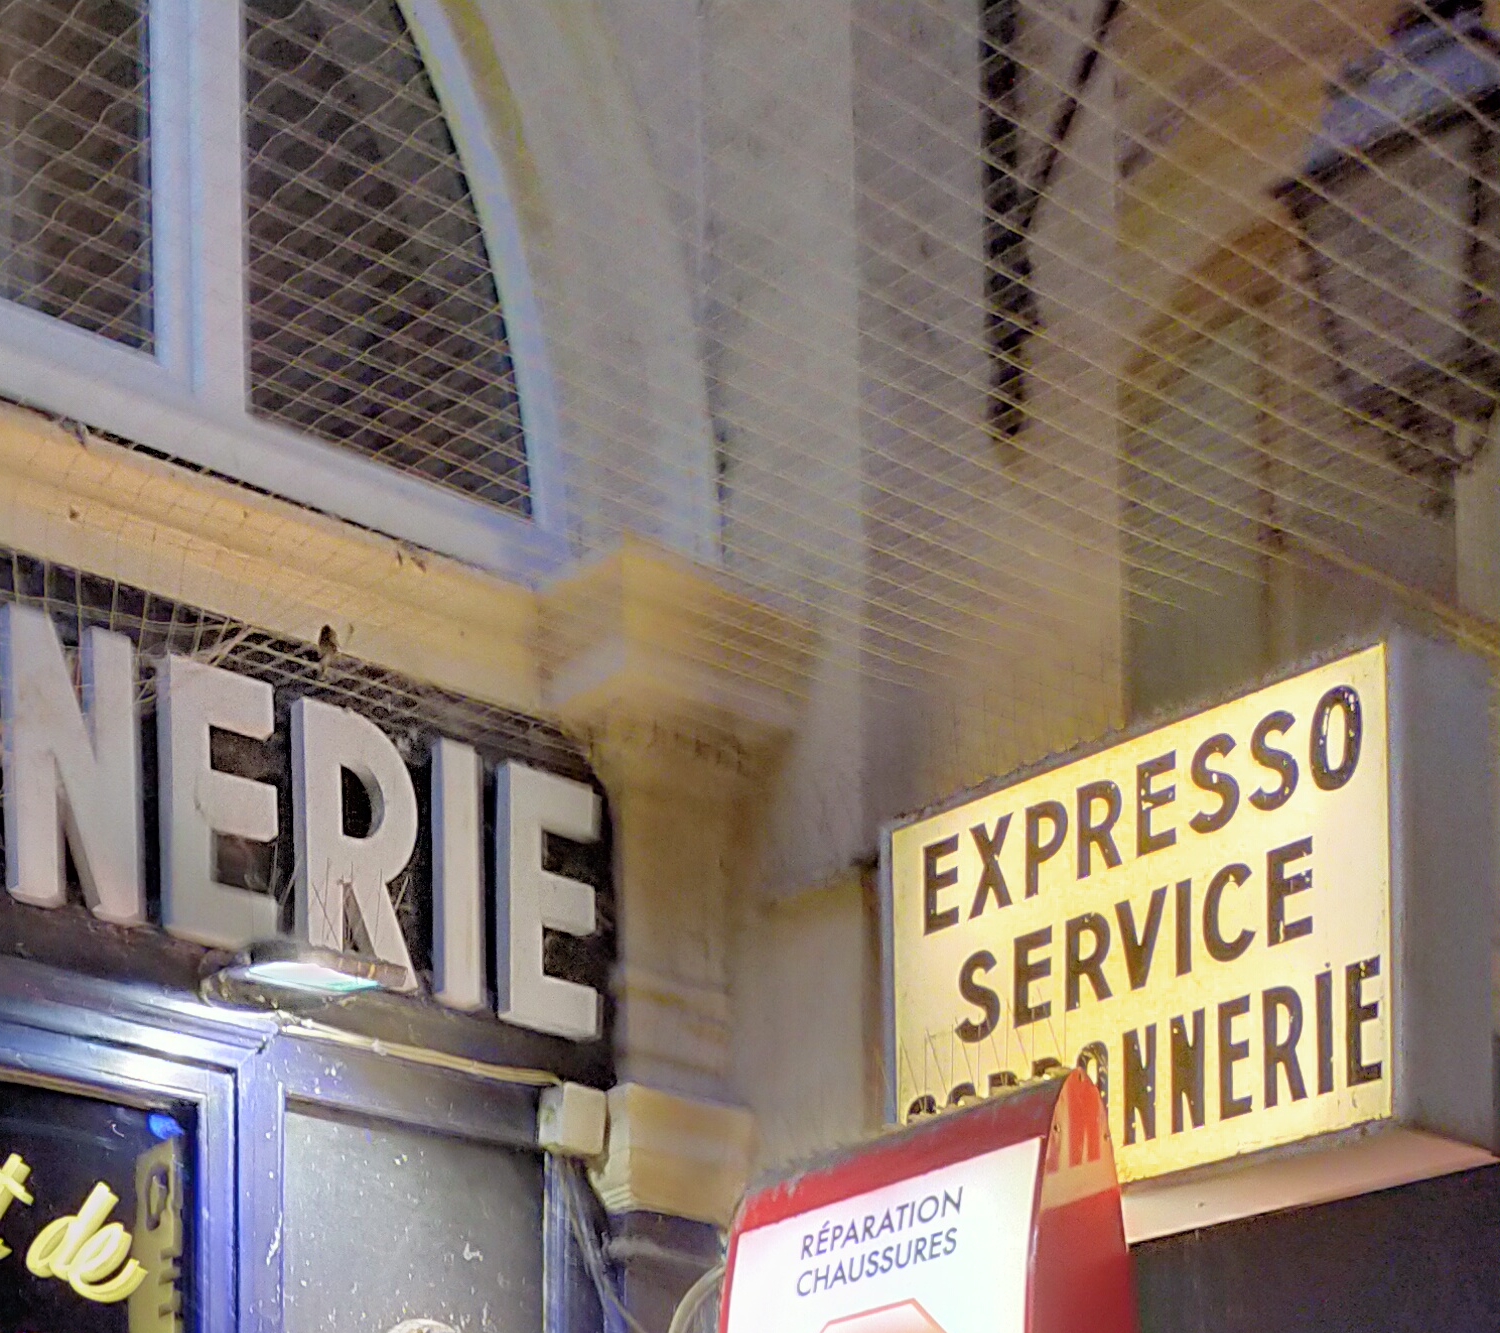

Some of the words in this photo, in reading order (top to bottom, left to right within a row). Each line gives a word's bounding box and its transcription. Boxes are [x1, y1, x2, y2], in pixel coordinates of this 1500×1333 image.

[923, 684, 1362, 936] EXPRESSO
[955, 836, 1314, 1043] SERVICE
[906, 955, 1382, 1148] ONNERIE
[26, 1181, 148, 1303] de
[796, 1228, 958, 1297] CHAUSSURES
[800, 1186, 964, 1260] RÉPARATION
